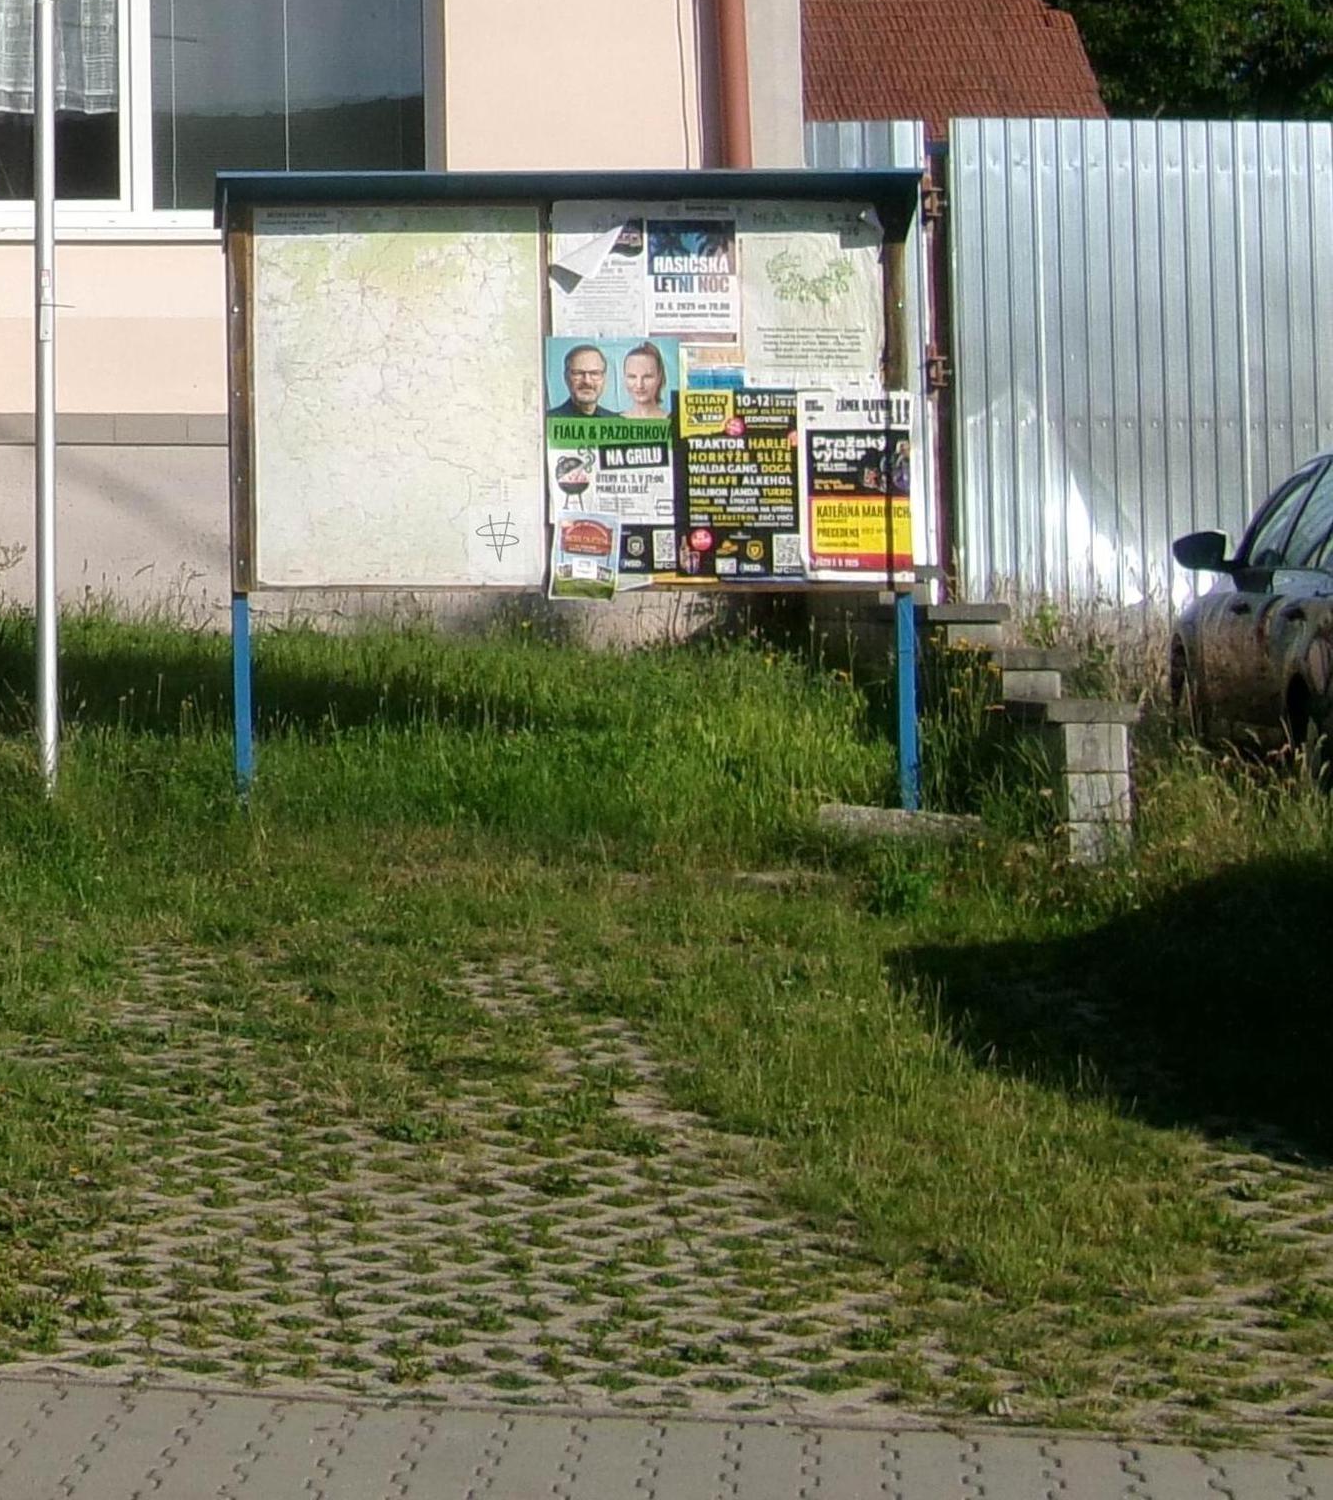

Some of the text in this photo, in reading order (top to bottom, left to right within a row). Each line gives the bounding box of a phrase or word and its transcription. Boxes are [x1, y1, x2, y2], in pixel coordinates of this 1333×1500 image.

[554, 425, 586, 440] FIALA
[589, 425, 598, 440] &
[688, 438, 791, 450] TRAKTOR HARLEJ
[605, 446, 663, 466] NA GRILU
[689, 450, 792, 462] HORKÝŽE SLÍŽE
[812, 447, 867, 462] výběr
[688, 463, 793, 473] WALDA GANG DOGA
[742, 475, 793, 485] ALKEHOL
[816, 502, 860, 518] KATEŘINA
